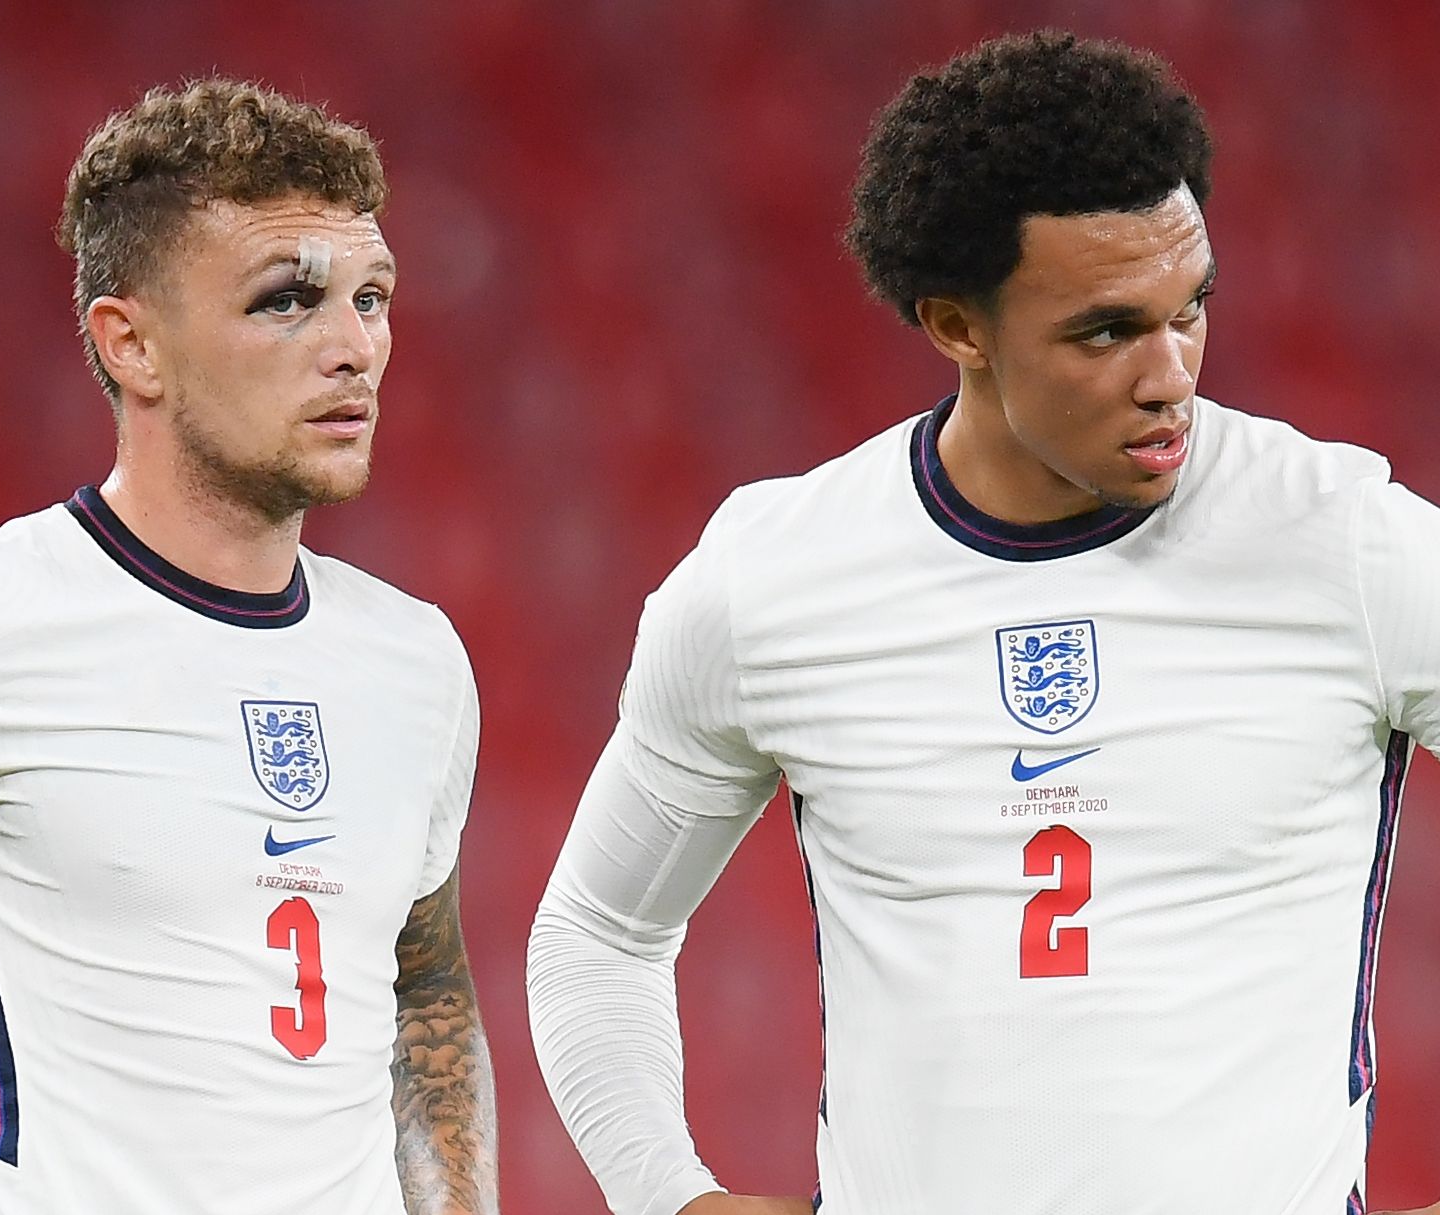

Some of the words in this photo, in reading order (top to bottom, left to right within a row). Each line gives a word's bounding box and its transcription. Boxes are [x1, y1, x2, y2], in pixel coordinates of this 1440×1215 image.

[1026, 786, 1080, 800] DENMARK
[1001, 805, 1007, 817] 8
[1011, 802, 1075, 816] SEPTEMBER
[1078, 799, 1108, 812] 2020
[256, 875, 263, 887] 8
[319, 882, 343, 894] 2020
[1021, 825, 1091, 978] 2
[267, 897, 327, 1060] 3
